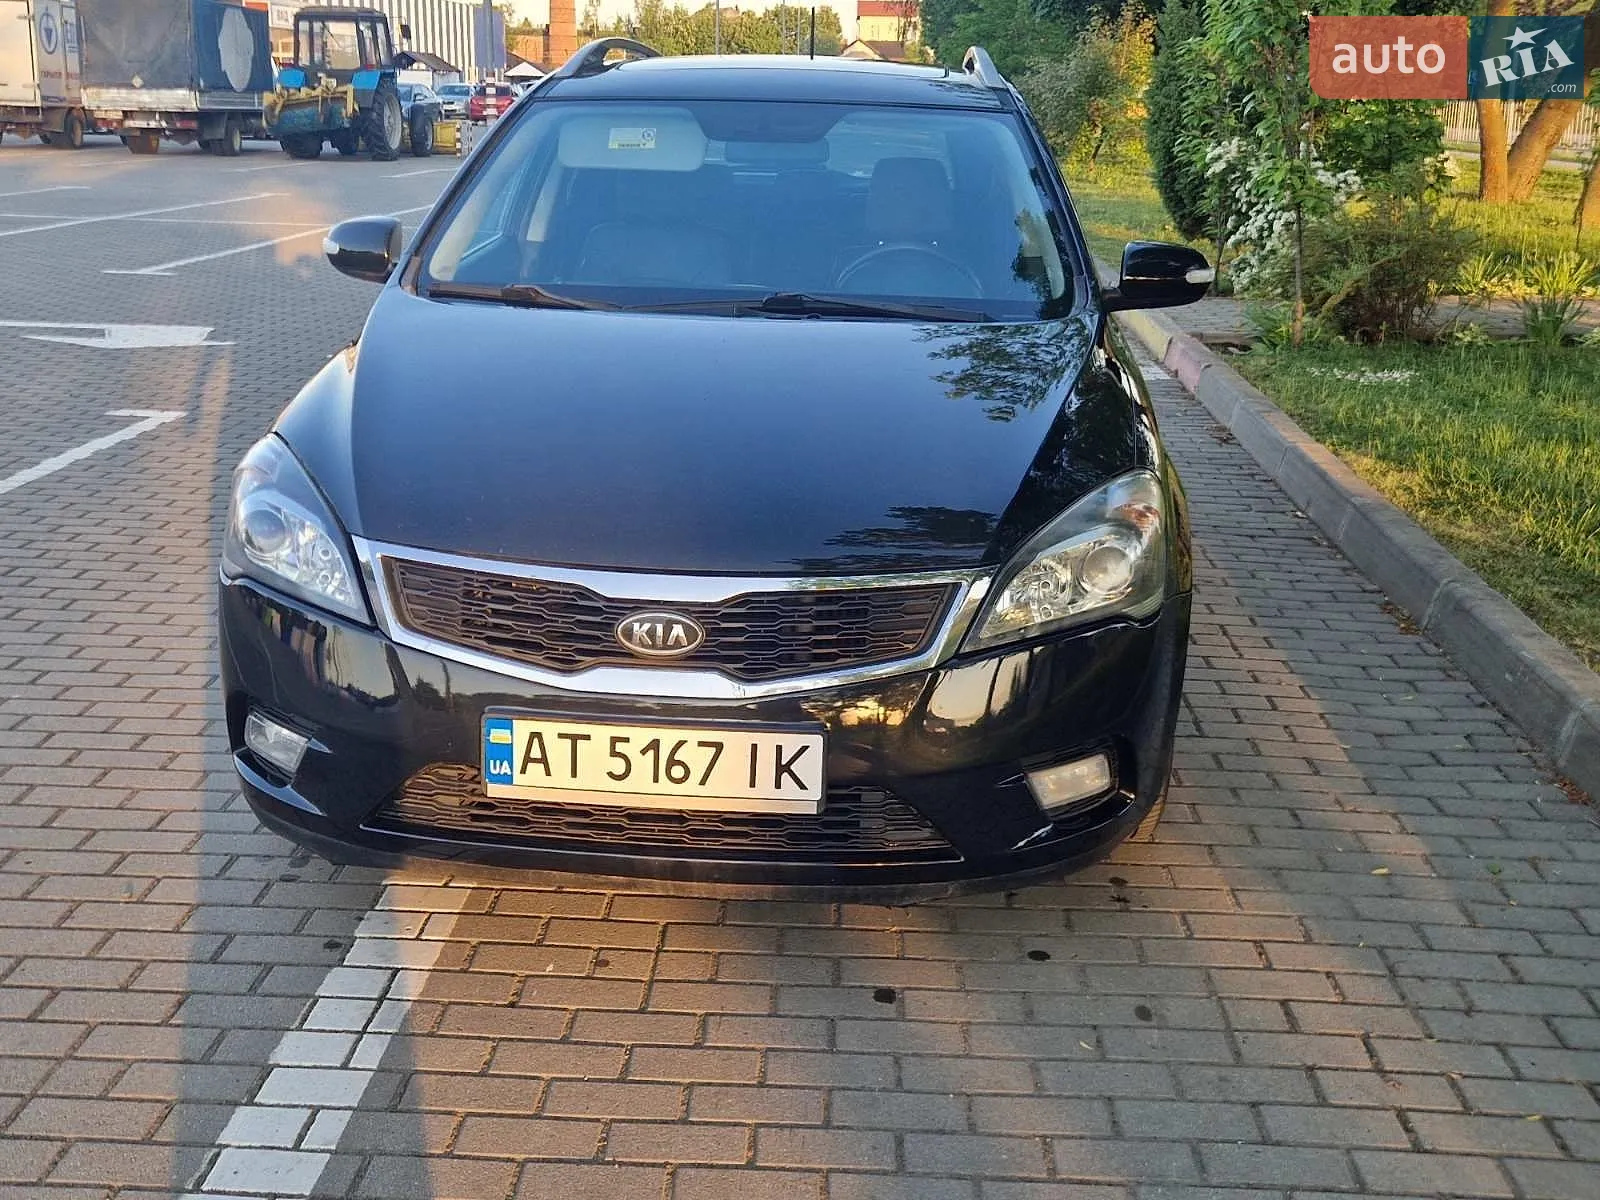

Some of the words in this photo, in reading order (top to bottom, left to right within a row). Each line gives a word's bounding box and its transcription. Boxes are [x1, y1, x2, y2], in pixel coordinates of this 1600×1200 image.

[631, 622, 689, 647] KIA
[489, 759, 511, 775] UA
[520, 732, 591, 778] AT
[606, 736, 725, 785] 5167
[749, 743, 811, 790] IK
